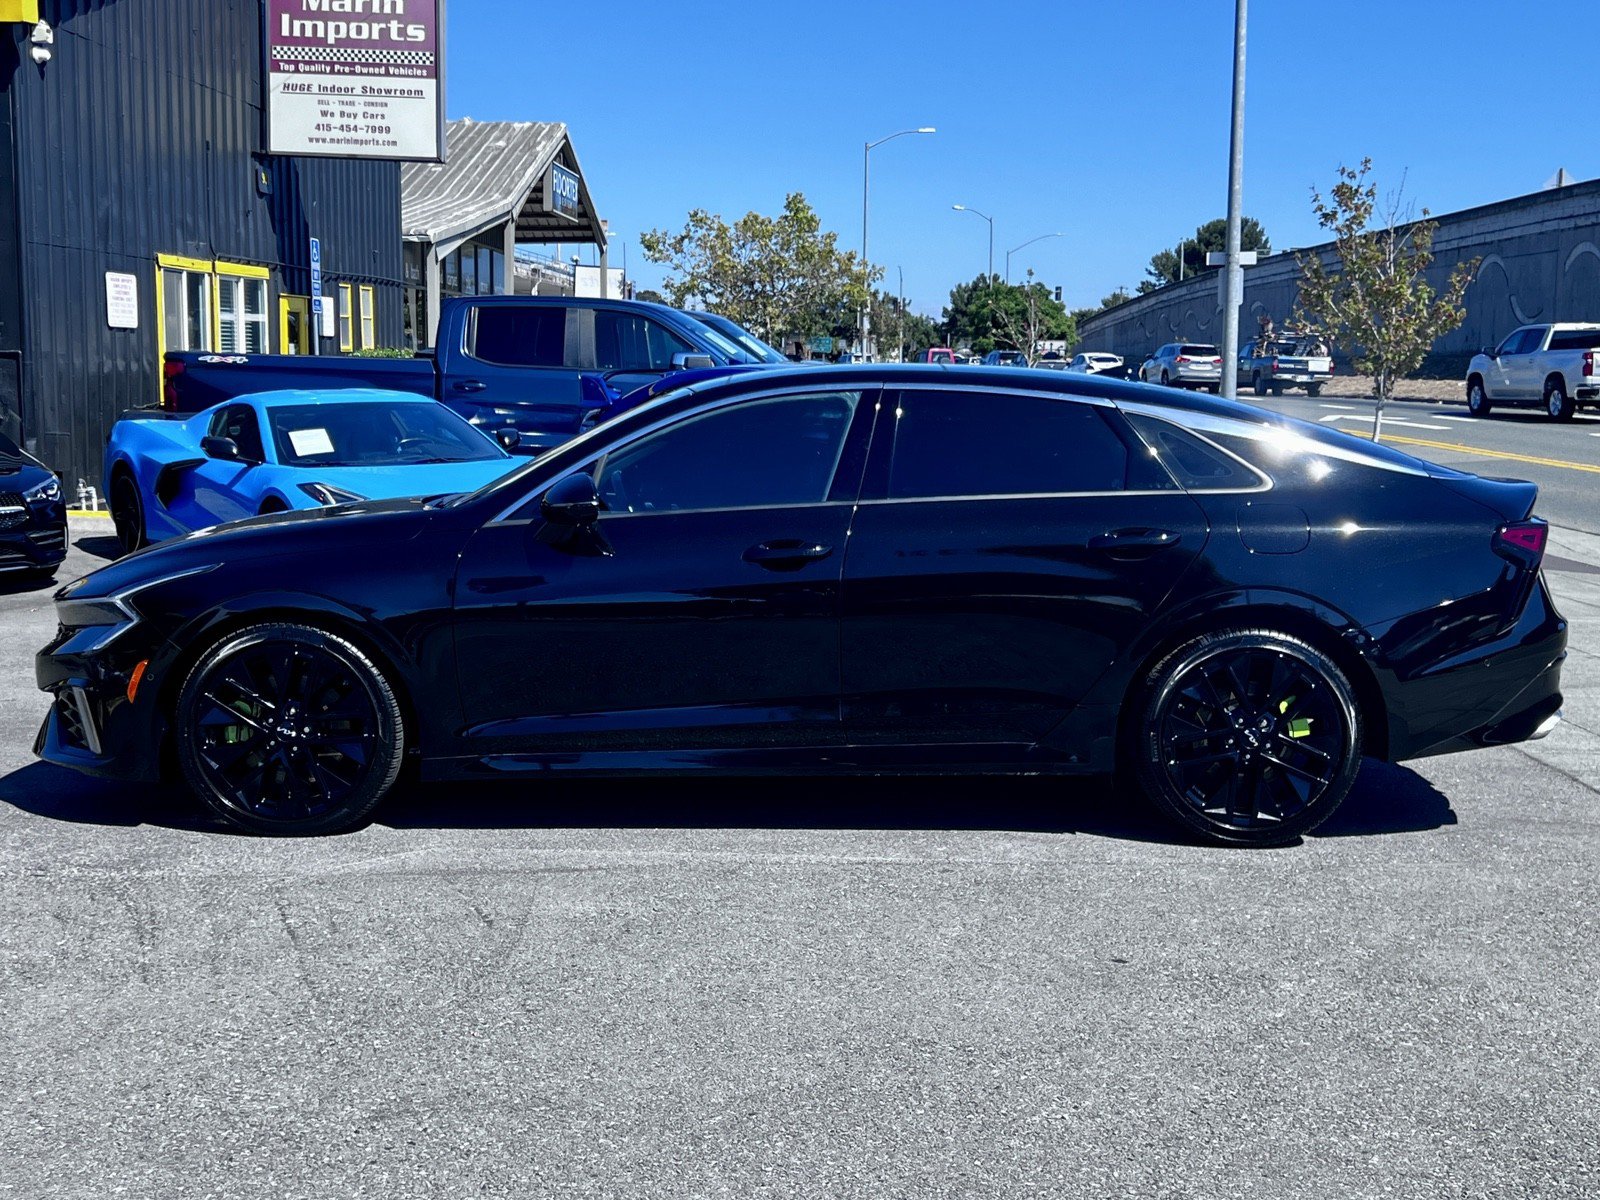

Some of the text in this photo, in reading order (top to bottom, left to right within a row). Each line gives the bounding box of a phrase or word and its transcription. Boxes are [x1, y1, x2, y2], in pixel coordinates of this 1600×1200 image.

[281, 13, 426, 44] Imports
[279, 62, 428, 77] Top Quality Pre-Owned Vehicles
[282, 82, 424, 96] HUGE Indoor Showroom
[320, 109, 386, 120] We Buy Cars
[315, 123, 392, 135] 415-454-7999
[308, 136, 398, 147] www.marinimports.com
